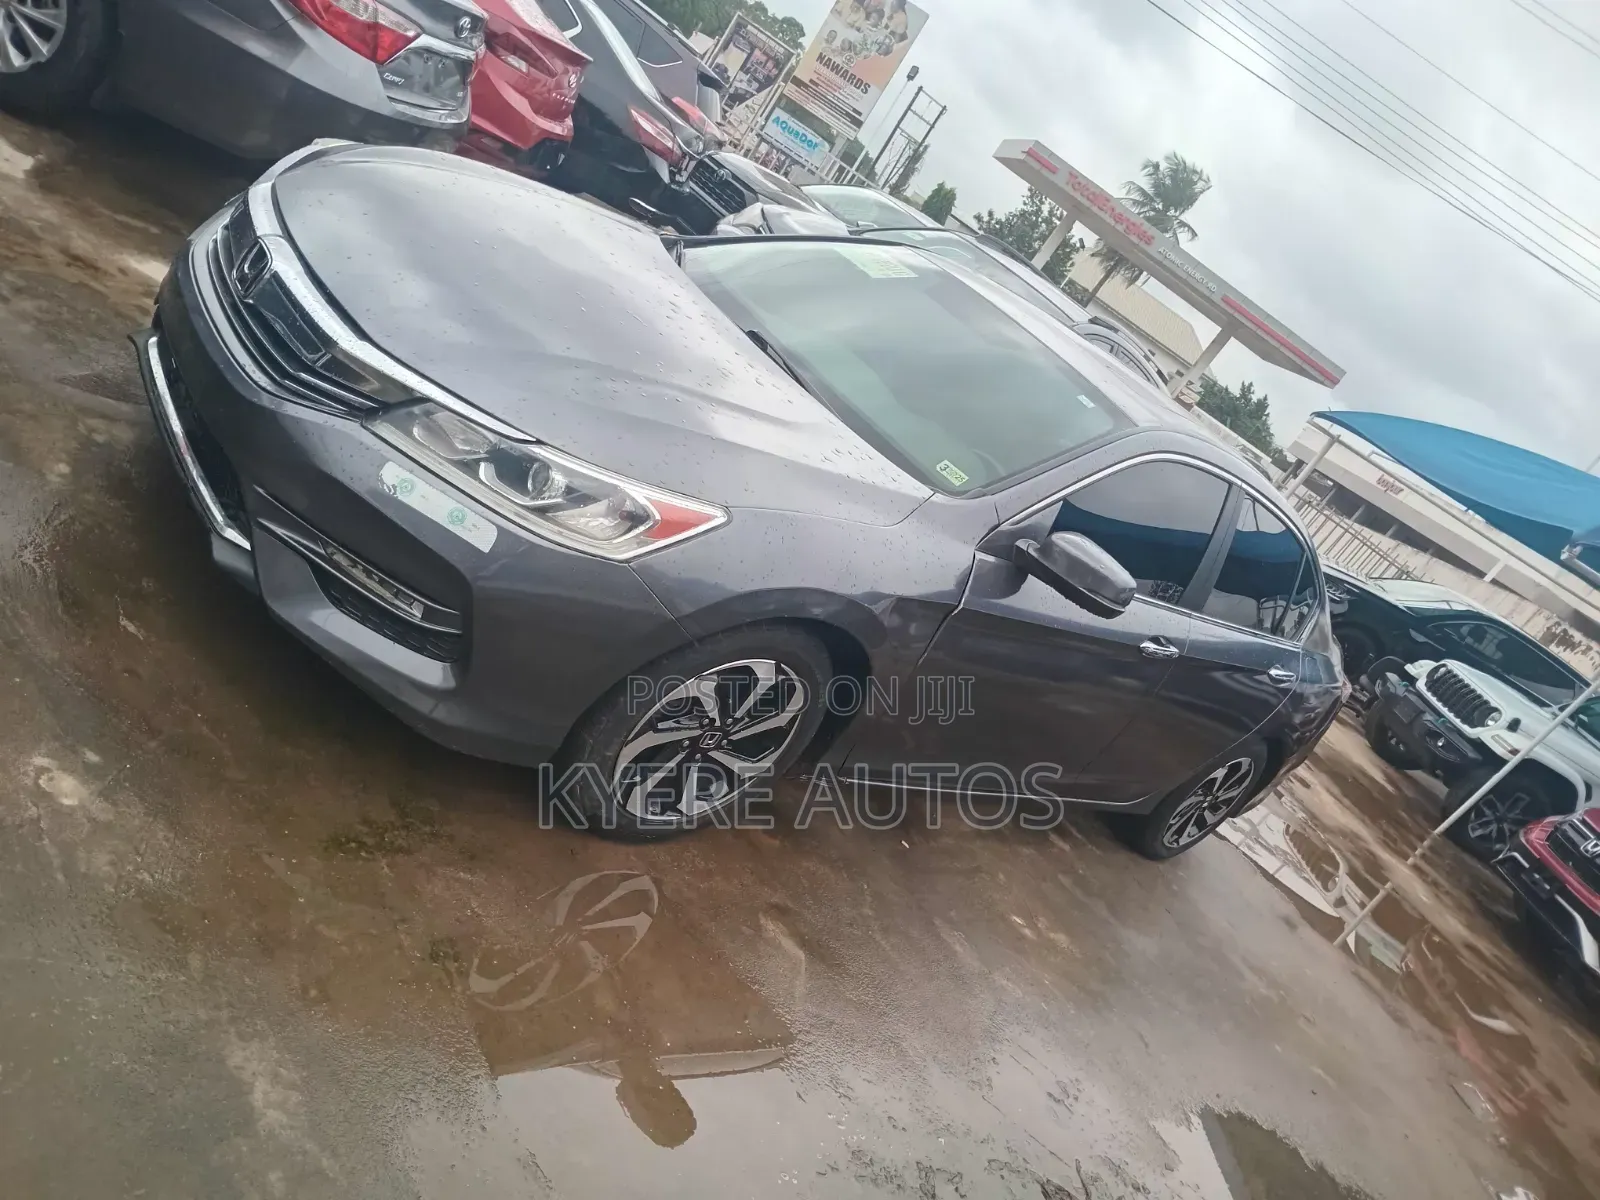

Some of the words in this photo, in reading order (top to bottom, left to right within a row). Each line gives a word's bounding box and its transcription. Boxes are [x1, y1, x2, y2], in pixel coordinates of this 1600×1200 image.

[816, 51, 871, 95] NAWARDS
[1066, 170, 1156, 246] TotalEnergies
[1157, 246, 1185, 268] ATOMIC
[1183, 264, 1207, 284] ENERGY
